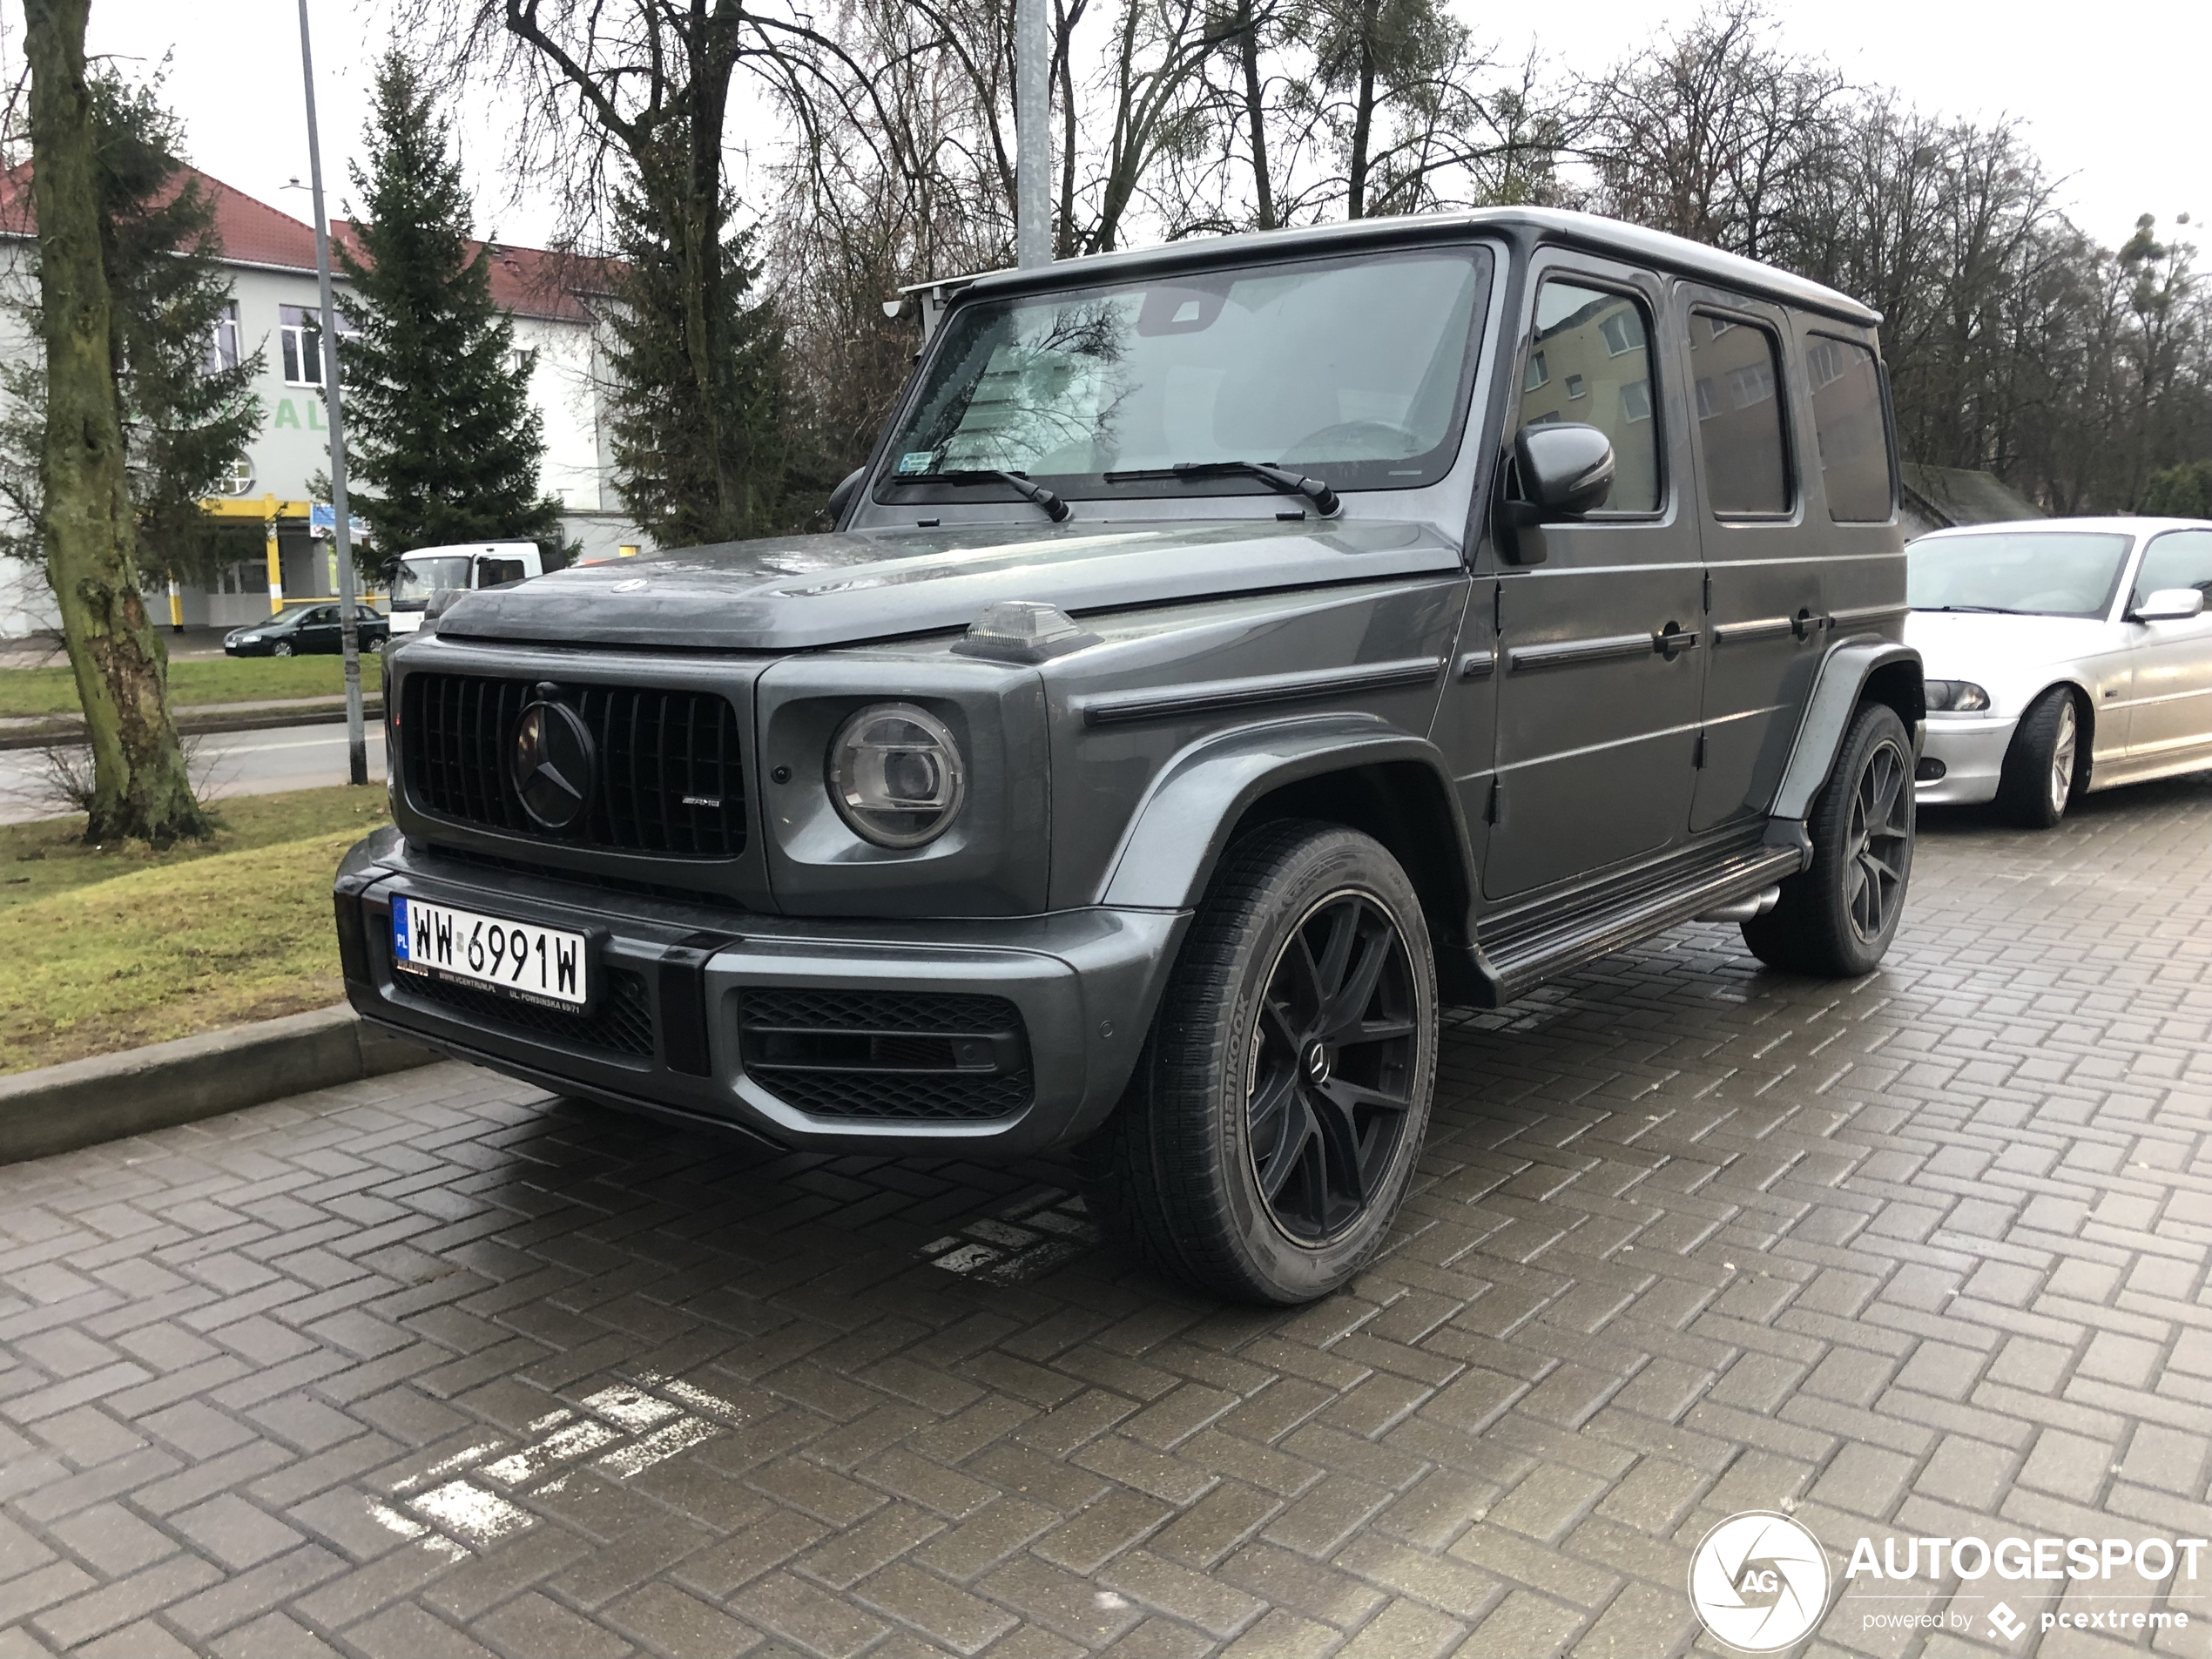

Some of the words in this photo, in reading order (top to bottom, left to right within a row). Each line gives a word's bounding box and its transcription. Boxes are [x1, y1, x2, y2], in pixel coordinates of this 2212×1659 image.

[397, 934, 408, 949] PL
[414, 907, 452, 966] WW
[469, 921, 576, 995] 6991W
